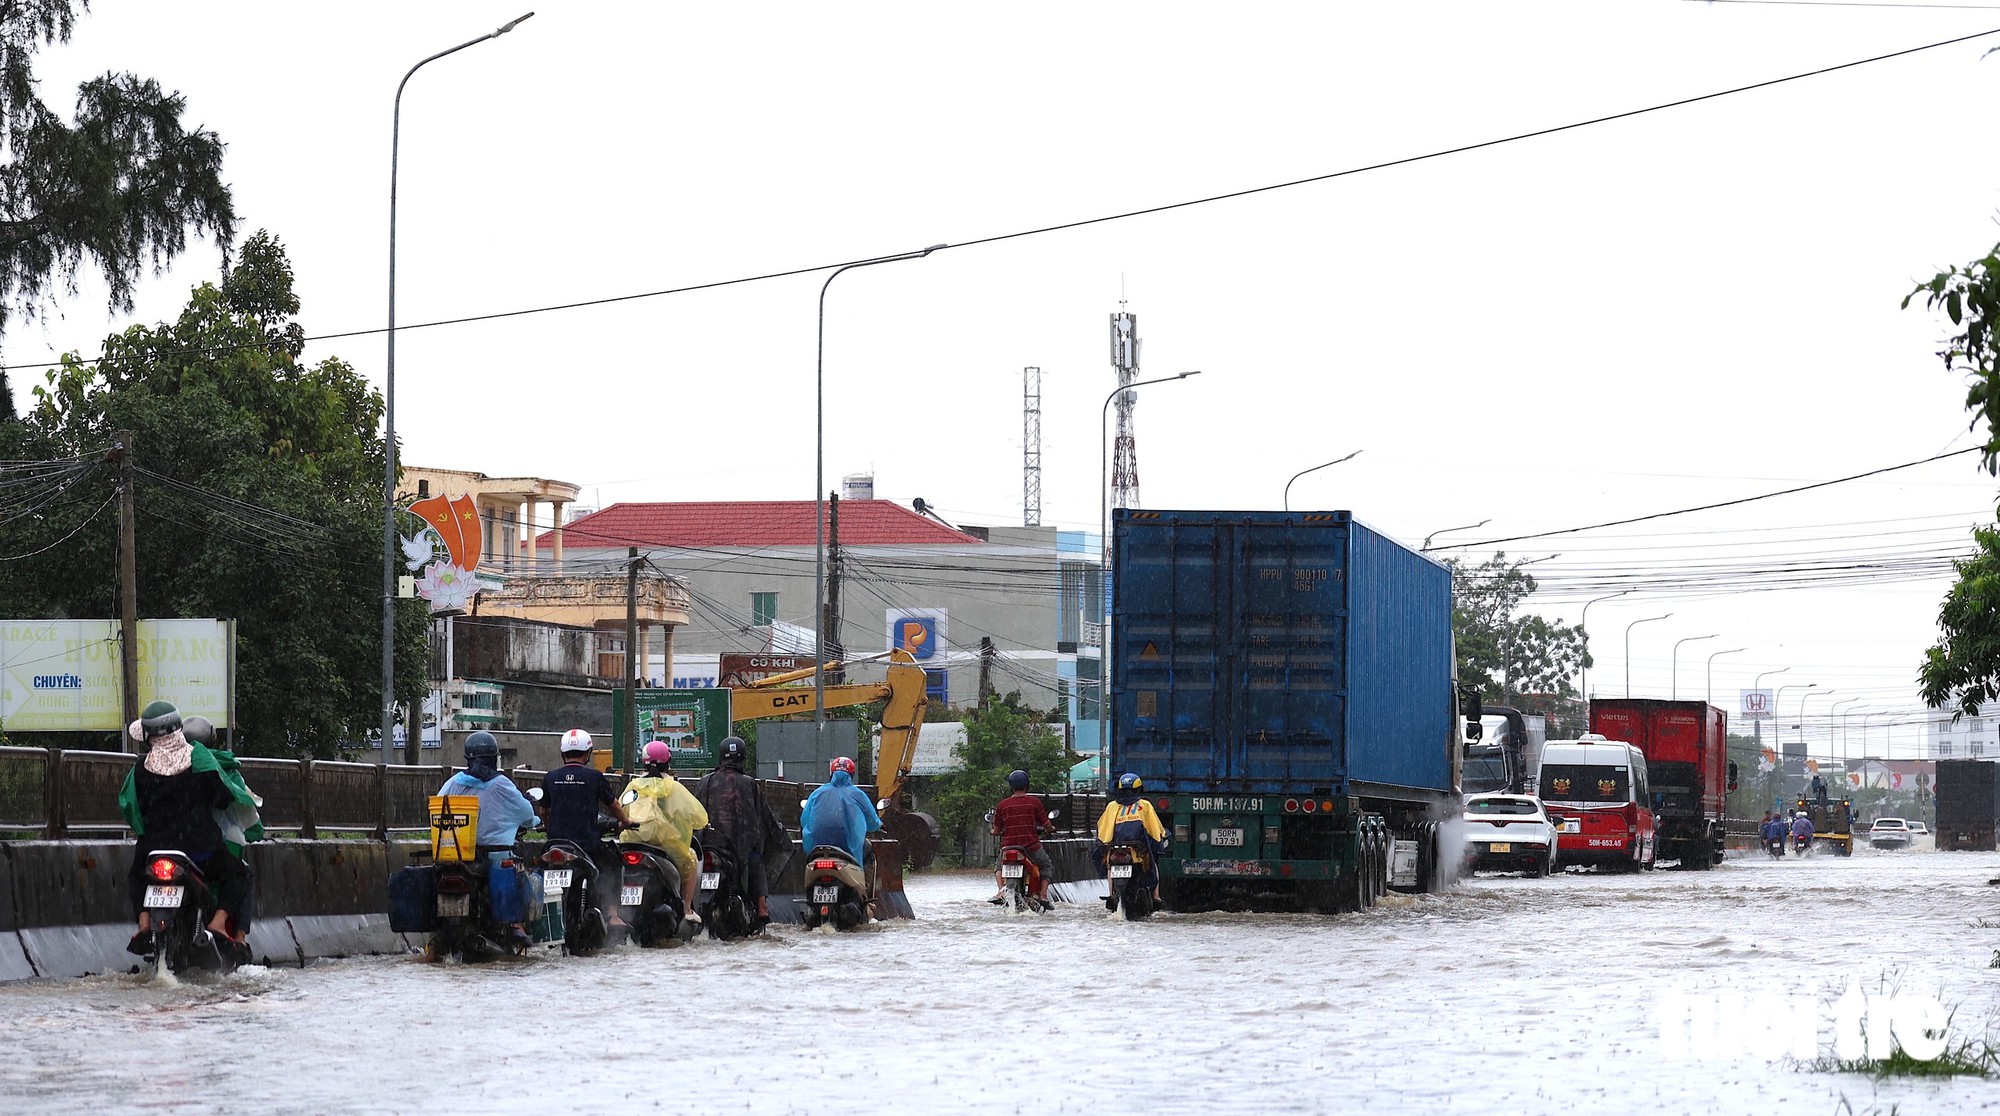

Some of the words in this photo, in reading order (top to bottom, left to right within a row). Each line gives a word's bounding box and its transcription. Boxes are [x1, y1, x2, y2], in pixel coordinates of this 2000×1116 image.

[1260, 568, 1282, 580] HPPU
[1294, 569, 1327, 580] 900110
[1252, 636, 1270, 647] TARE
[772, 657, 796, 668] KHÍ
[34, 673, 82, 688] CHUYÊN:
[773, 694, 809, 708] CAT
[1193, 797, 1263, 811] 50RM-137.91
[1217, 829, 1237, 838] 50RM
[1215, 837, 1240, 845] 137.91
[152, 886, 179, 896] 86-B3
[148, 896, 180, 906] 103.33
